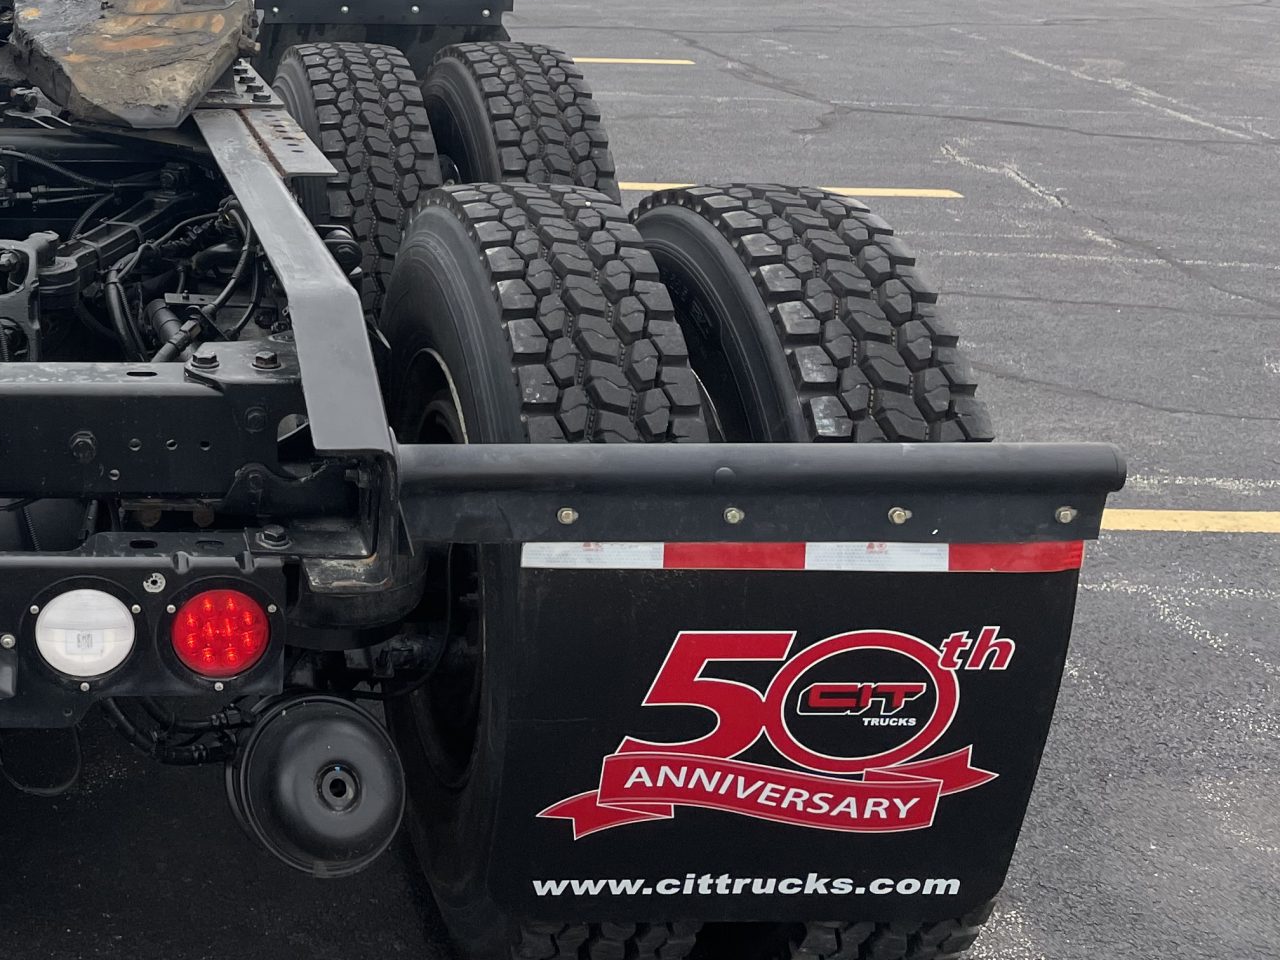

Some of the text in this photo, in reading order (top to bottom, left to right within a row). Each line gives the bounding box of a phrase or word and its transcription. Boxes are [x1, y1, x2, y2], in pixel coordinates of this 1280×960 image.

[797, 681, 927, 716] CIT
[862, 717, 918, 726] TRUCKS
[623, 765, 921, 820] ANNIVERSARY
[531, 872, 962, 897] www.cittrucks.com
